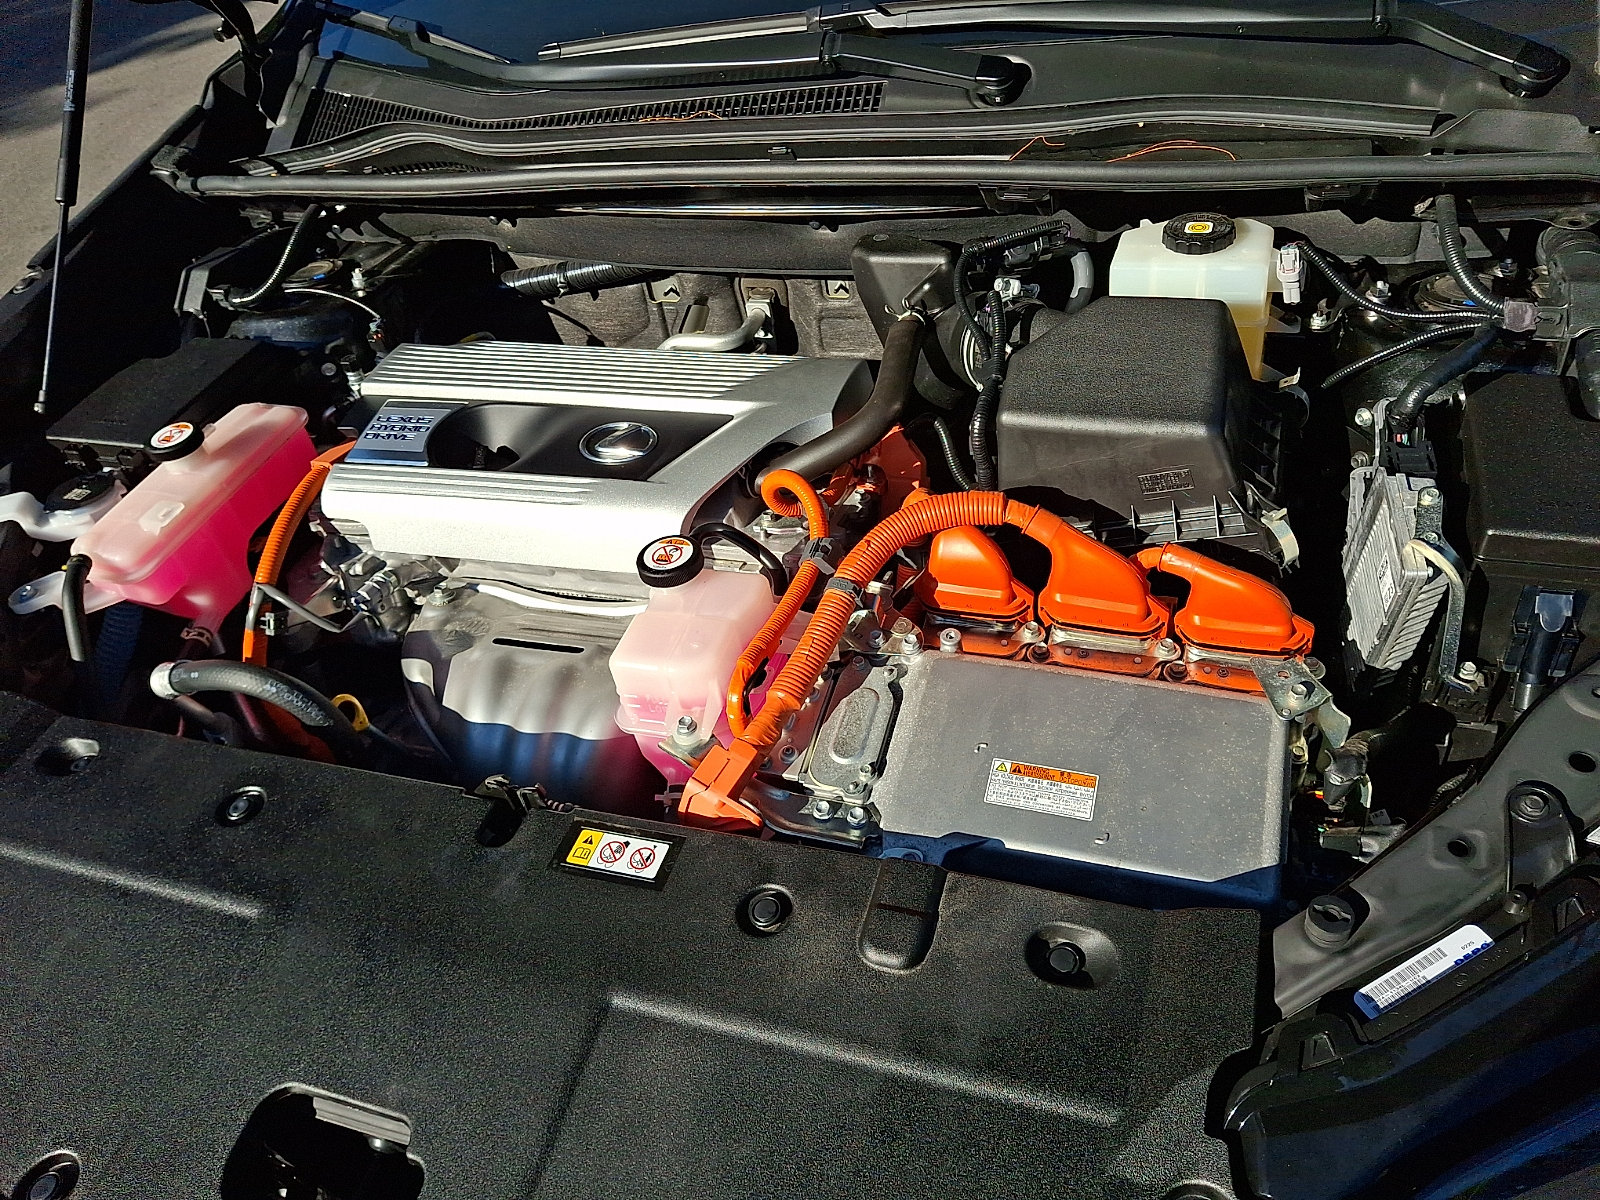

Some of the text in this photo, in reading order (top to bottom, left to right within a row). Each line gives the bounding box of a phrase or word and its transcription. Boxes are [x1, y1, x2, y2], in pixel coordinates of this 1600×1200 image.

[377, 414, 435, 423] LEXUS
[369, 423, 431, 433] HYBRID
[363, 431, 417, 441] DRIVE
[1454, 942, 1490, 967] DEPO
